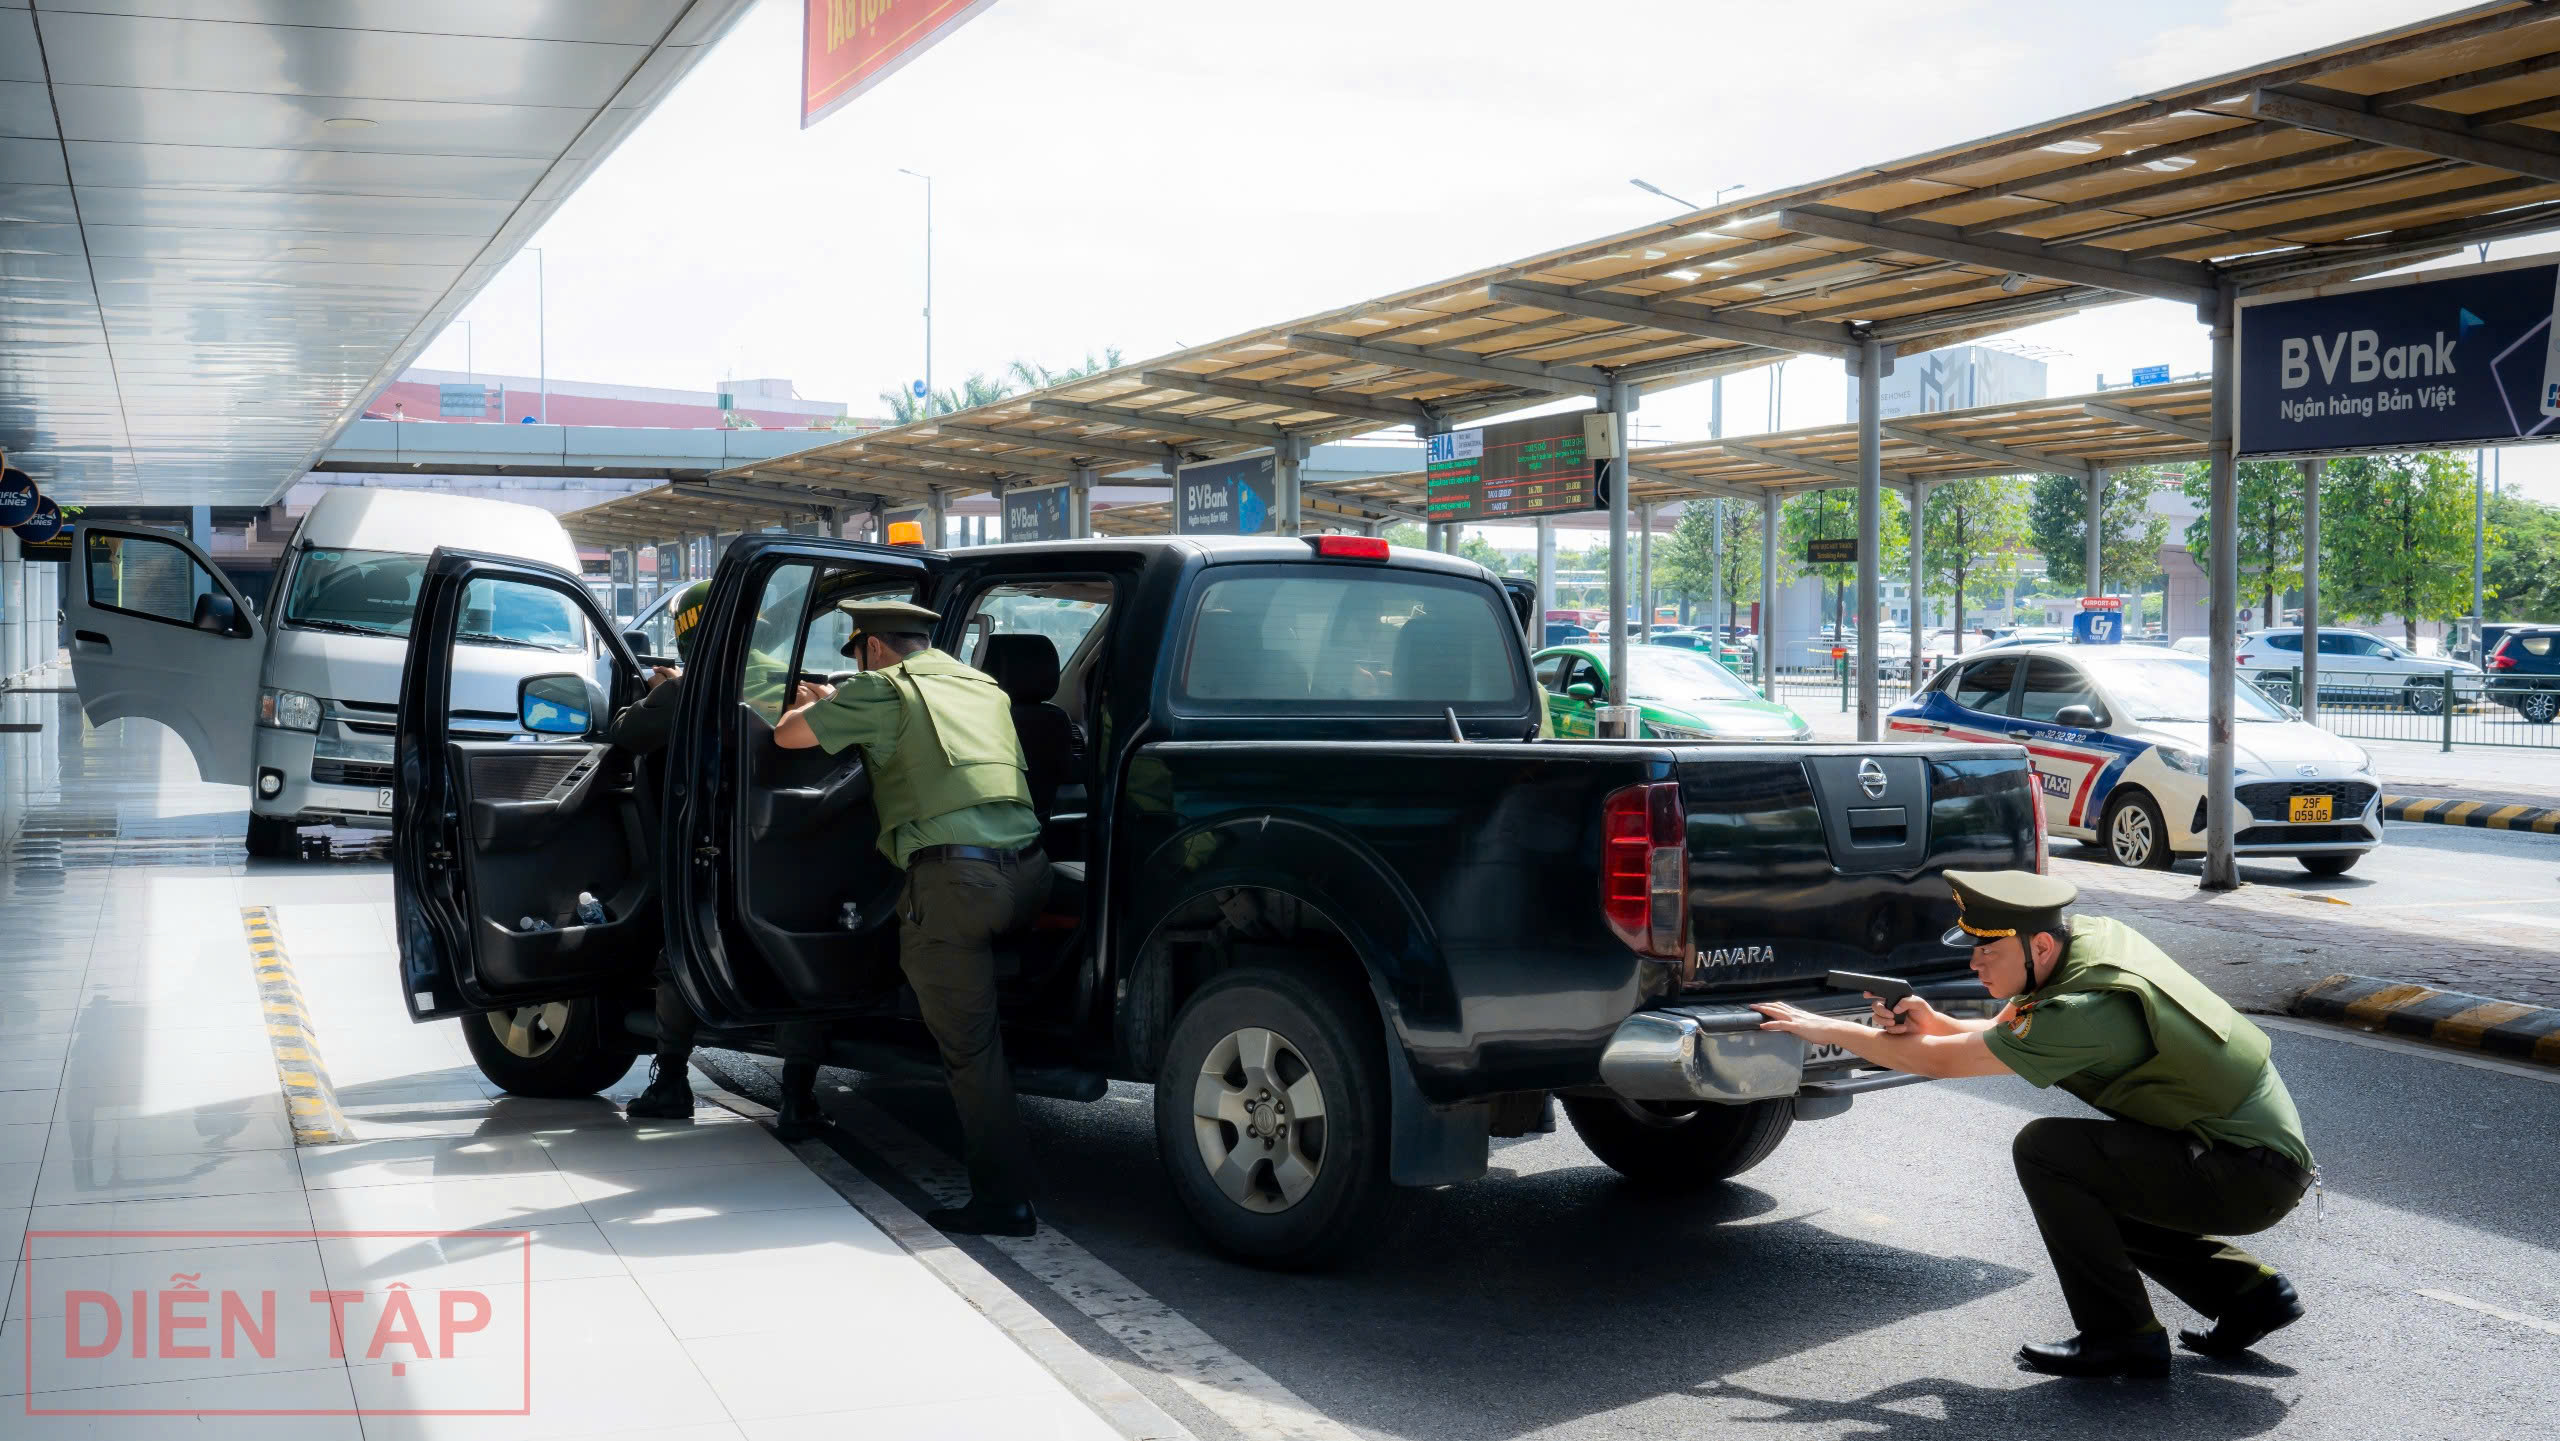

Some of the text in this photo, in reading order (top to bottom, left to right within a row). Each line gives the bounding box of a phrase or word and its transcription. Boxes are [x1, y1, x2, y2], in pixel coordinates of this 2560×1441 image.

[2281, 329, 2457, 390] BVBank
[2281, 385, 2457, 423] Ngân hàng Bản Việt
[1431, 434, 1455, 461] NIA
[0, 491, 19, 499] IFIC
[1188, 484, 1228, 511] BVBank
[1011, 507, 1039, 529] BVBank
[2090, 615, 2113, 641] G7
[2045, 729, 2056, 739] 32
[2055, 731, 2066, 741] 32
[2065, 732, 2076, 742] 32
[2075, 734, 2087, 743] 32
[2042, 774, 2071, 794] TAXI
[2302, 798, 2321, 809] 29F
[2294, 809, 2328, 821] 059.05
[1696, 945, 1775, 968] NAVARA
